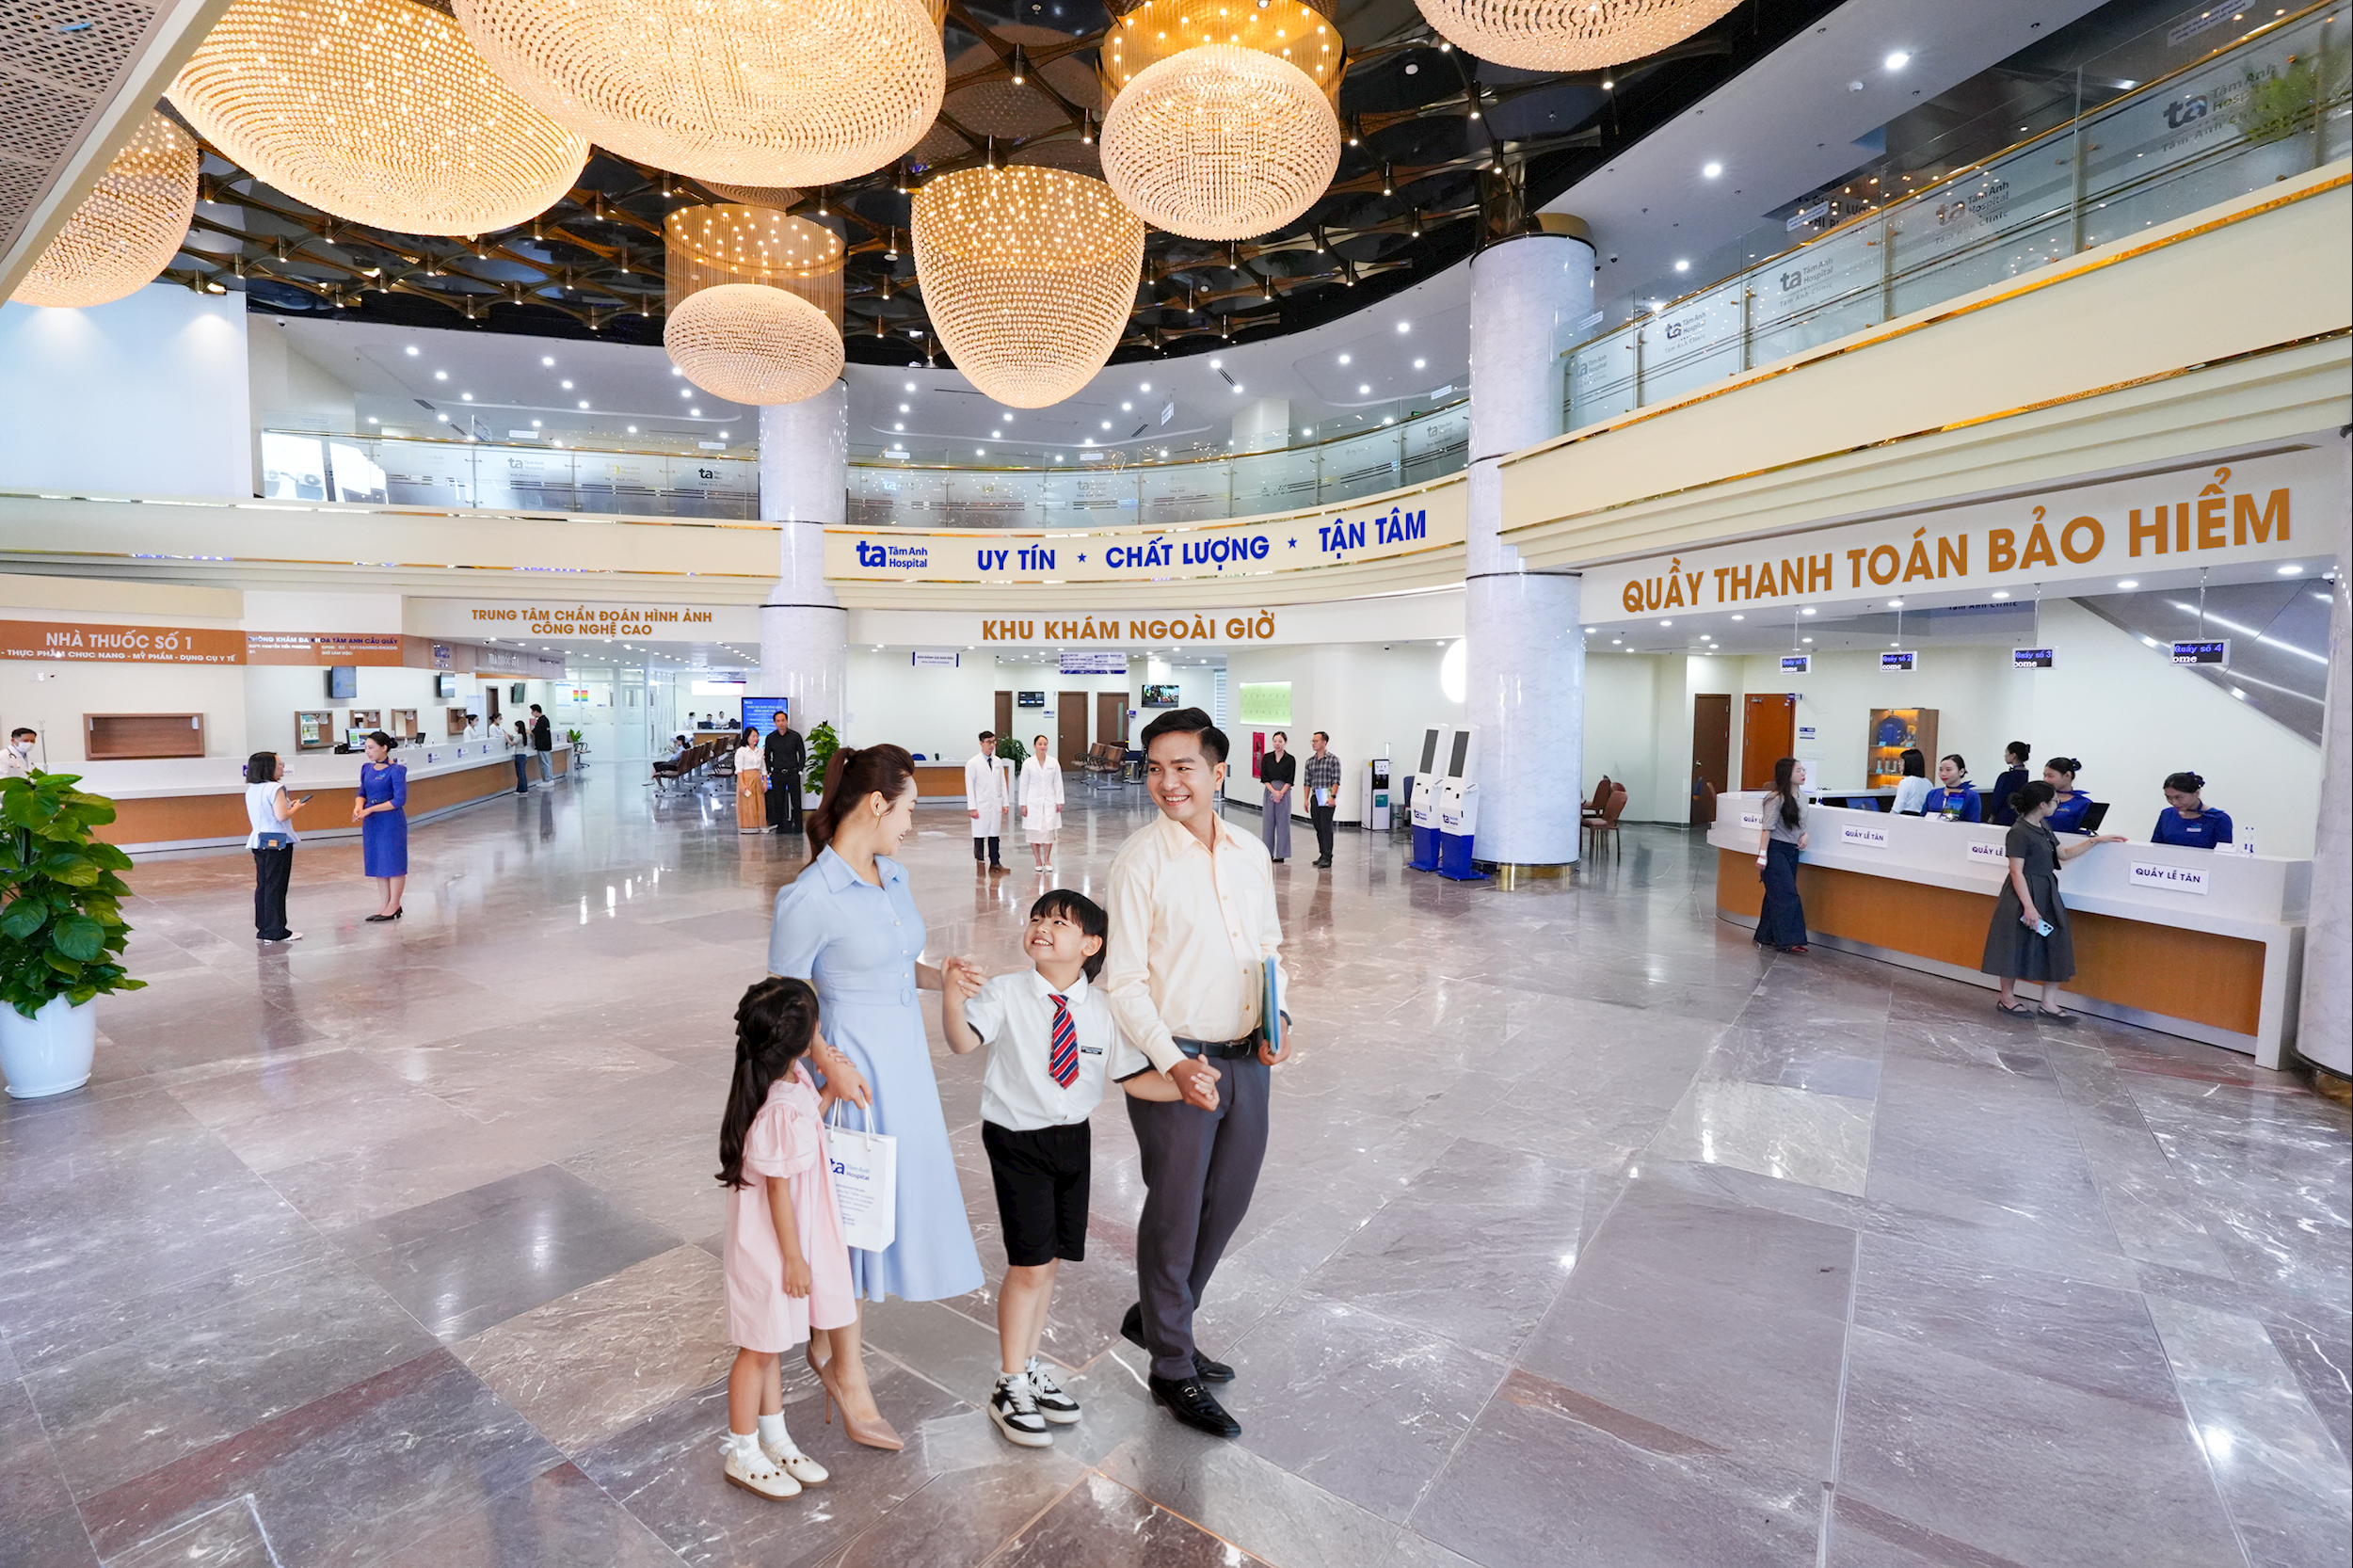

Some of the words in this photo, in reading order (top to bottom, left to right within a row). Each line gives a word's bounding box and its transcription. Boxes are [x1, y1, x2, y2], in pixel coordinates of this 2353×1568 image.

[2163, 95, 2207, 129] ta
[2194, 122, 2222, 138] Anh
[1989, 182, 2009, 195] Anh
[1969, 192, 2009, 215] Hospital
[1935, 200, 1965, 226] ta
[1979, 211, 2008, 227] Clinic
[1802, 264, 1817, 275] Tâm
[1818, 257, 1833, 268] Anh
[1780, 270, 1801, 292] ta
[1803, 266, 1833, 284] Hospital
[1682, 317, 1694, 327] Tâm
[1694, 312, 1706, 322] Anh
[1683, 320, 1706, 334] Hospital
[1665, 322, 1682, 341] ta
[1689, 334, 1705, 345] Clinic
[1427, 425, 1438, 438] ta
[508, 457, 523, 470] ta
[698, 468, 713, 480] ta
[1077, 480, 1090, 490] ta
[978, 550, 1009, 570] UY
[1017, 543, 1055, 570] TÍN
[1105, 536, 1174, 568] CHẤT
[1183, 536, 1270, 571] LƯỢNG
[1319, 518, 1366, 559] TẬN
[1375, 506, 1427, 545] TÂM
[1623, 557, 1705, 613] QUẦY
[1714, 552, 1833, 603] THANH
[1847, 526, 1968, 588] TOÁN
[1988, 505, 2105, 573] BẢO
[2128, 467, 2291, 558] HIỂM
[856, 540, 887, 568] ta
[888, 546, 908, 556] Tâm
[909, 547, 928, 556] Anh
[888, 558, 928, 569] Hospital
[472, 609, 518, 620] TRUNG
[521, 607, 550, 621] TÂM
[554, 605, 595, 622] CHẨN
[599, 608, 640, 622] ĐOÁN
[645, 608, 679, 622] HÌNH
[682, 608, 712, 623] ẢNH
[532, 620, 574, 634] CÔNG
[579, 622, 616, 637] NGHỆ
[621, 624, 652, 635] CAO
[983, 620, 1033, 640] KHU
[1045, 616, 1119, 640] KHÁM
[1129, 614, 1215, 640] NGOÀI
[1225, 609, 1274, 640] GIỜ
[46, 629, 84, 647] NHÀ
[88, 629, 150, 648] THUỐC
[154, 631, 180, 650] SỐ
[184, 636, 192, 650] 1
[2214, 643, 2223, 652] 4
[7, 649, 34, 658] THỰC
[2046, 650, 2052, 659] 3
[1846, 829, 1863, 838] QUẦY
[1871, 833, 1883, 841] TÂN
[1972, 845, 1993, 856] QUẦY
[2136, 867, 2164, 878] QUẦY
[2167, 870, 2177, 880] LỄ
[2180, 872, 2201, 884] TÂN
[846, 1171, 871, 1181] Hospital
